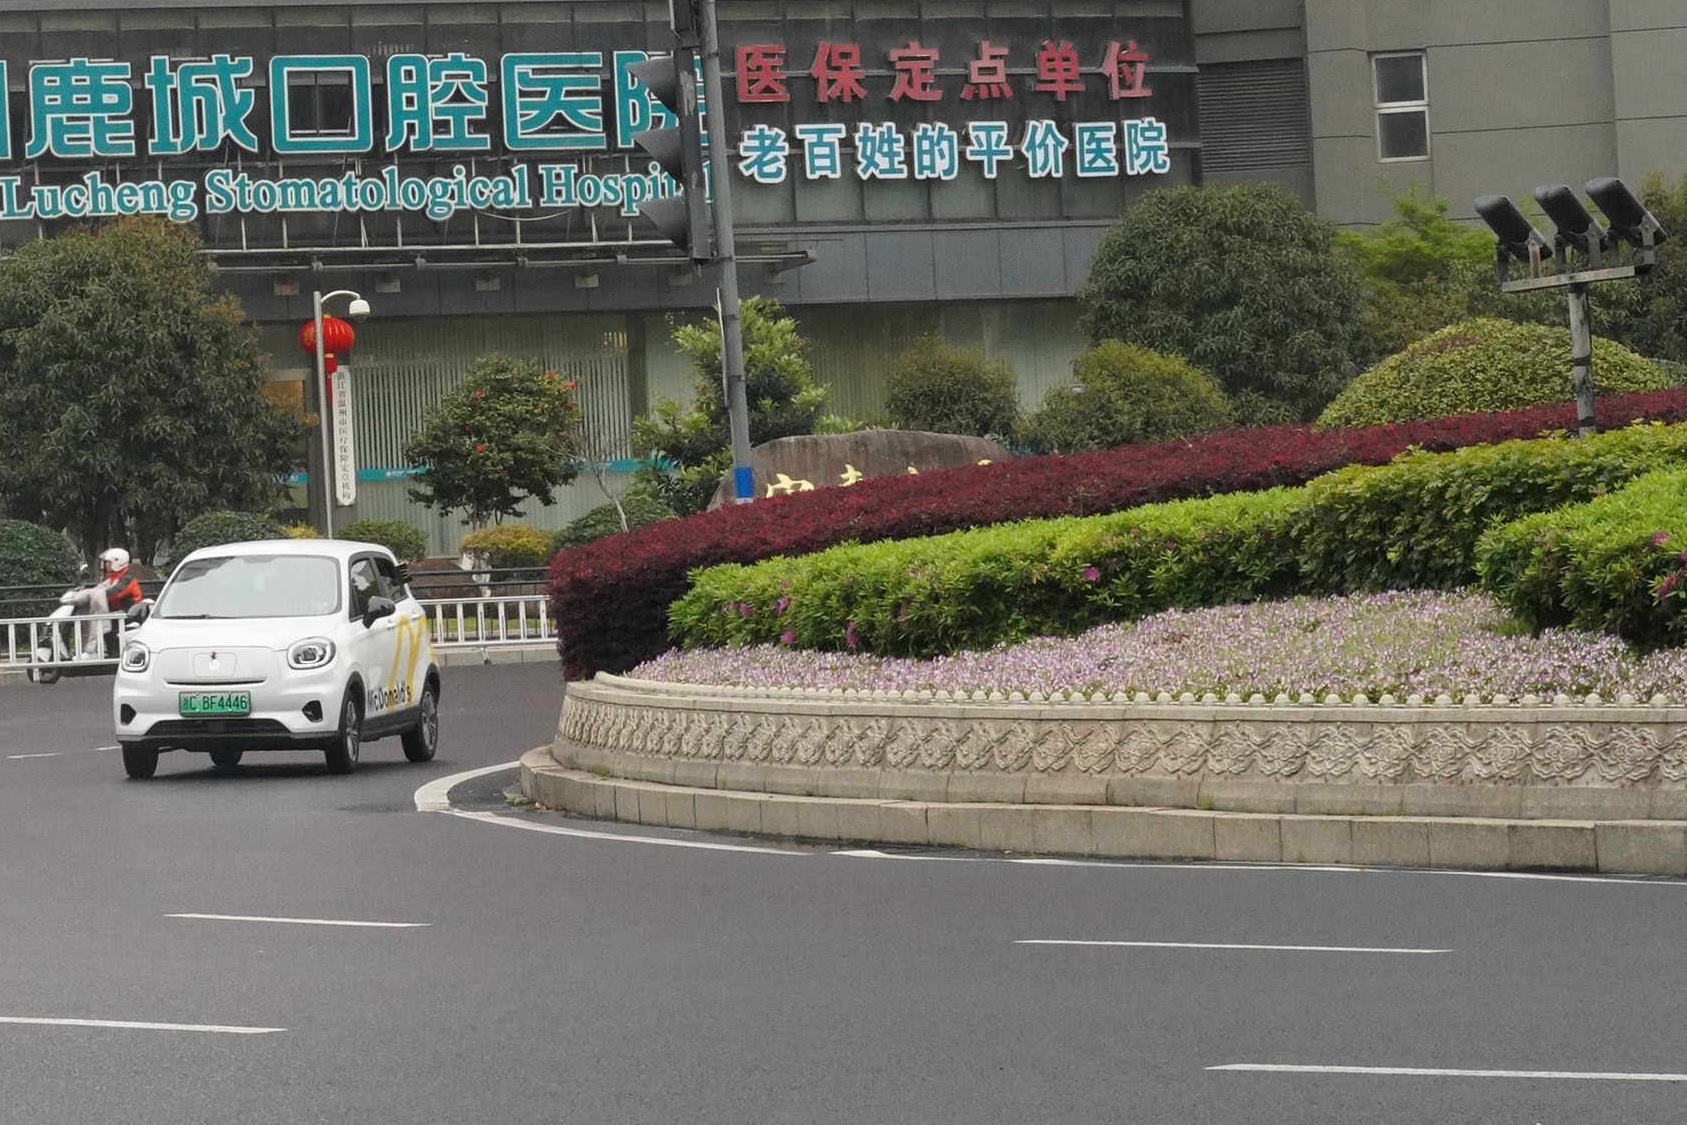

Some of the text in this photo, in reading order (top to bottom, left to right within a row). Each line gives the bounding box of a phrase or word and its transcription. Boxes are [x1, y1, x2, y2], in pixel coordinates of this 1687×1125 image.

[736, 40, 1152, 103] 医保定点单位
[738, 116, 1171, 183] 老百姓的平价医院
[204, 162, 530, 222] Stomatological
